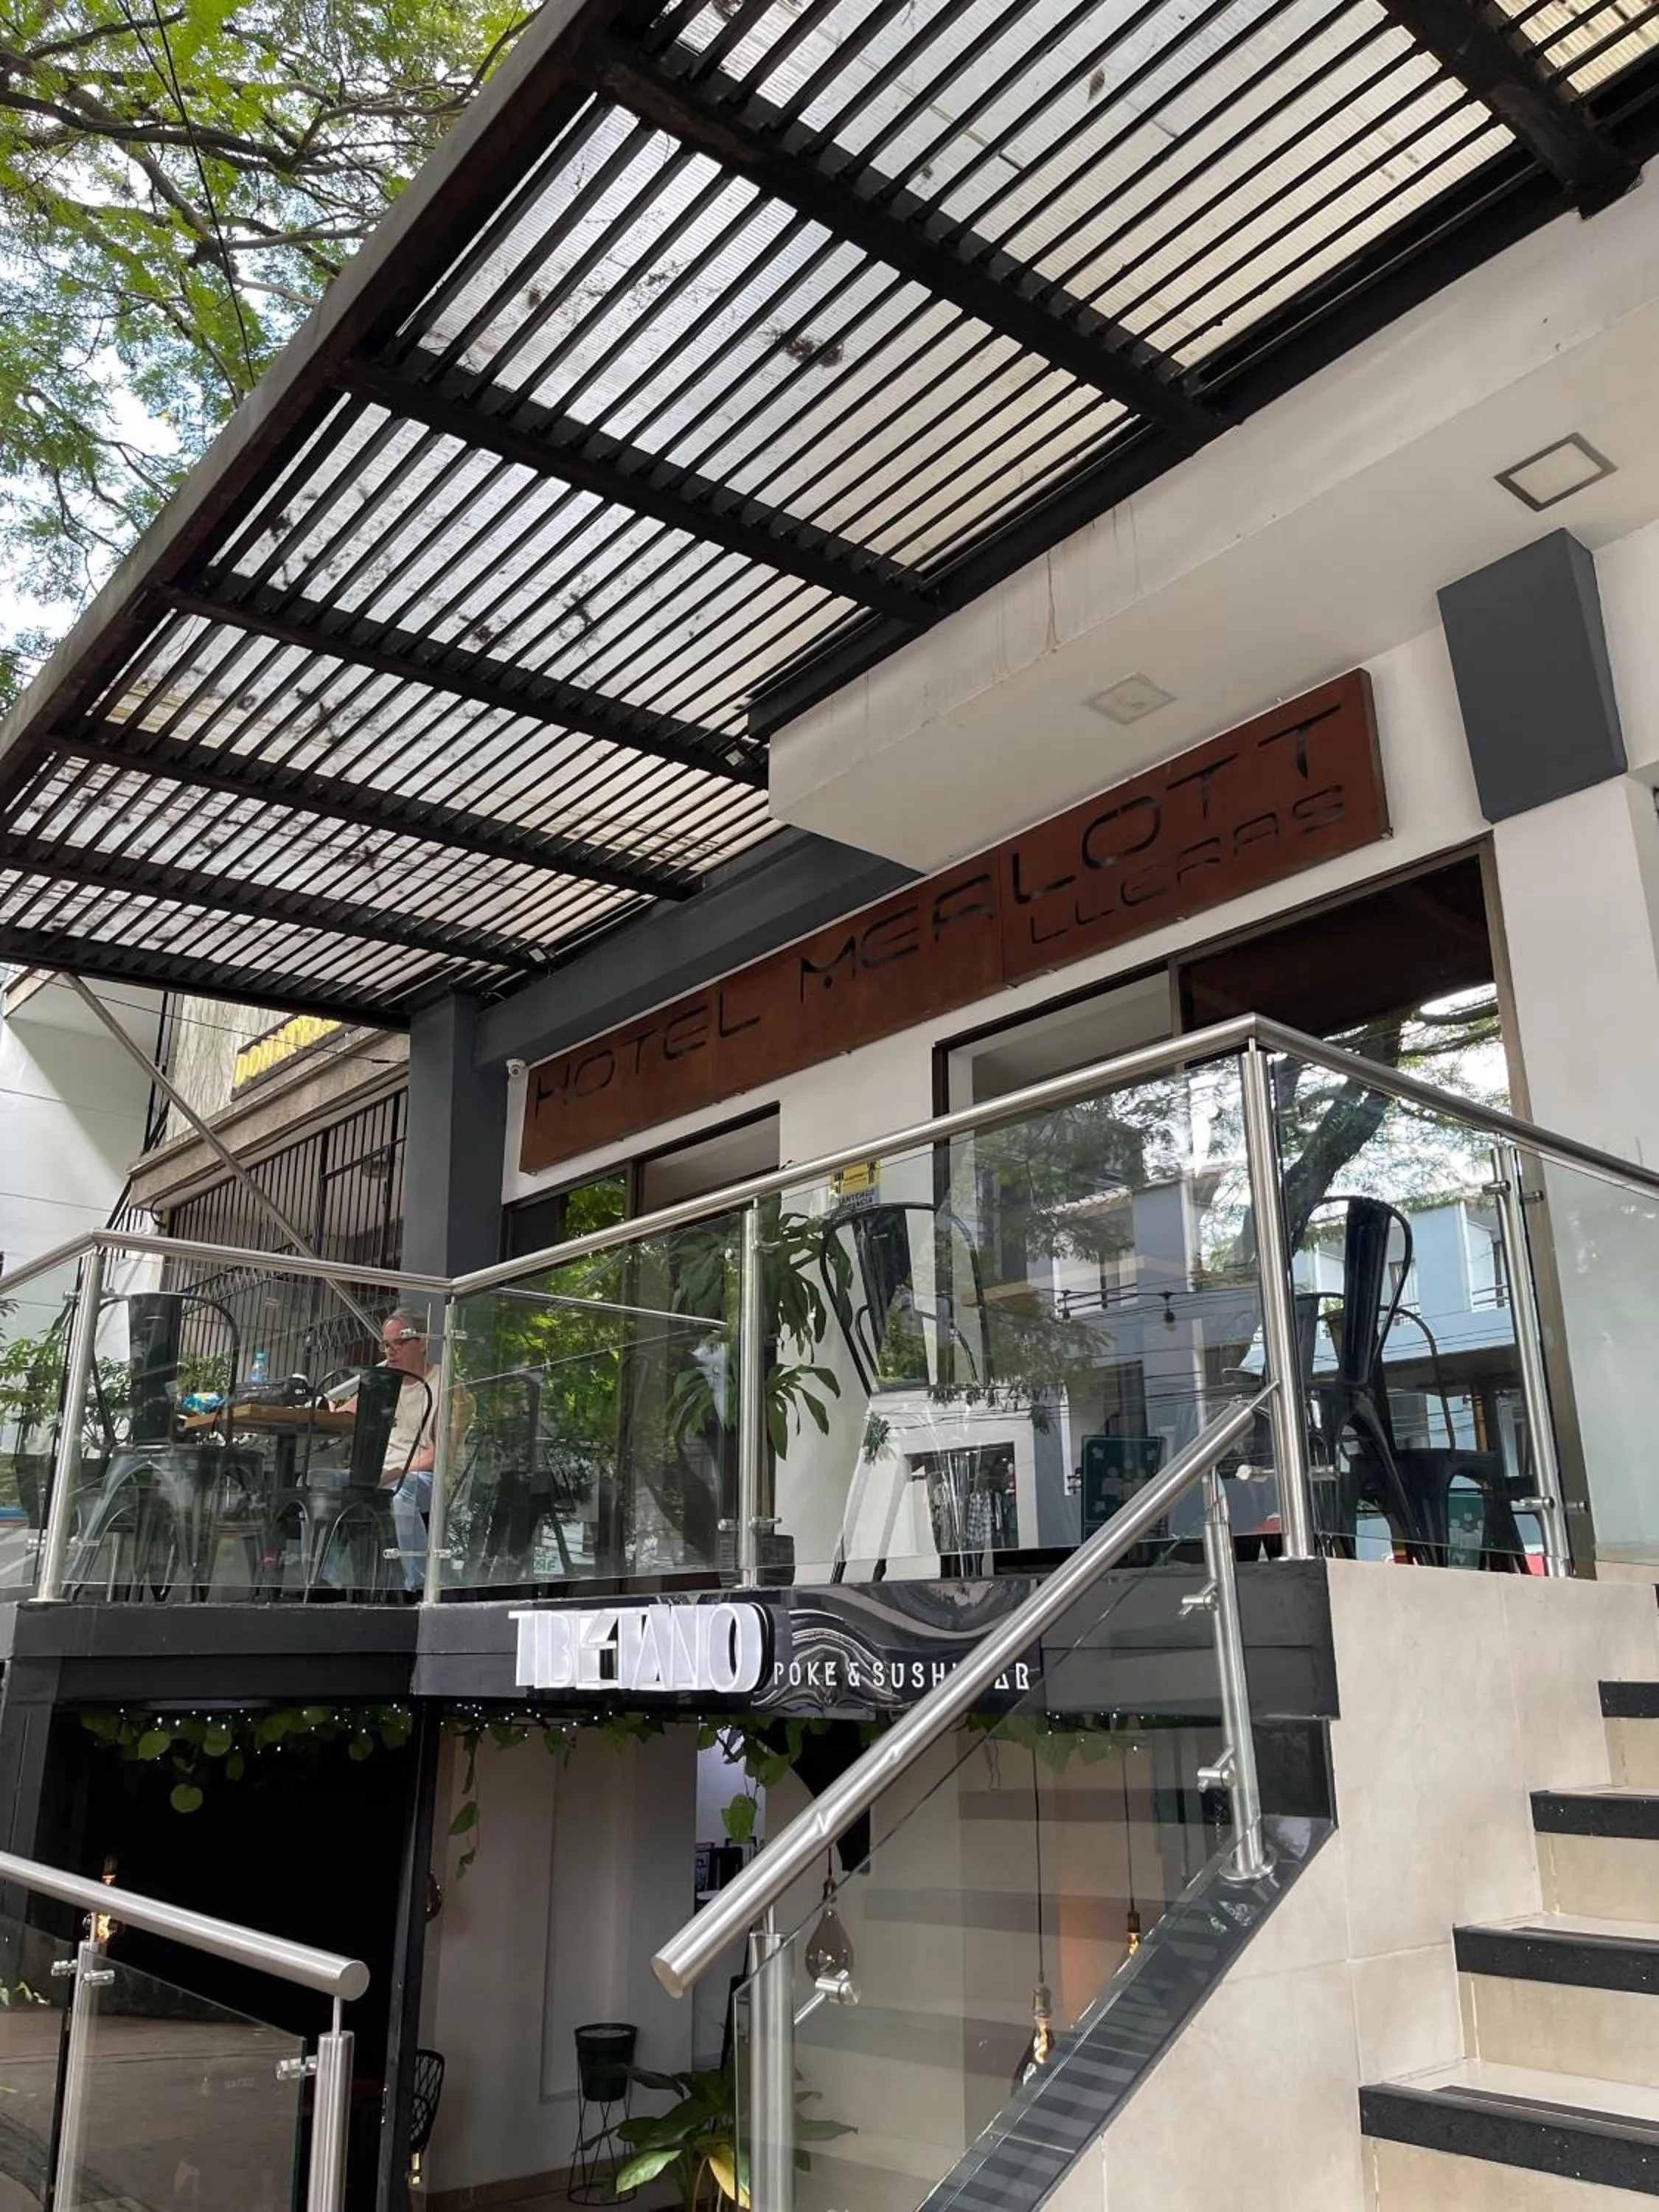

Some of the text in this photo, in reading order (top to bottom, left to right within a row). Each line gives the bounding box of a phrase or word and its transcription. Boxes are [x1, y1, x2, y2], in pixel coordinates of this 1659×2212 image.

[1029, 785, 1345, 945] LLERAS
[534, 990, 760, 1119] HOTEL
[773, 1661, 838, 1687] POKE
[848, 1661, 861, 1688] &
[873, 1662, 956, 1689] SUSH
